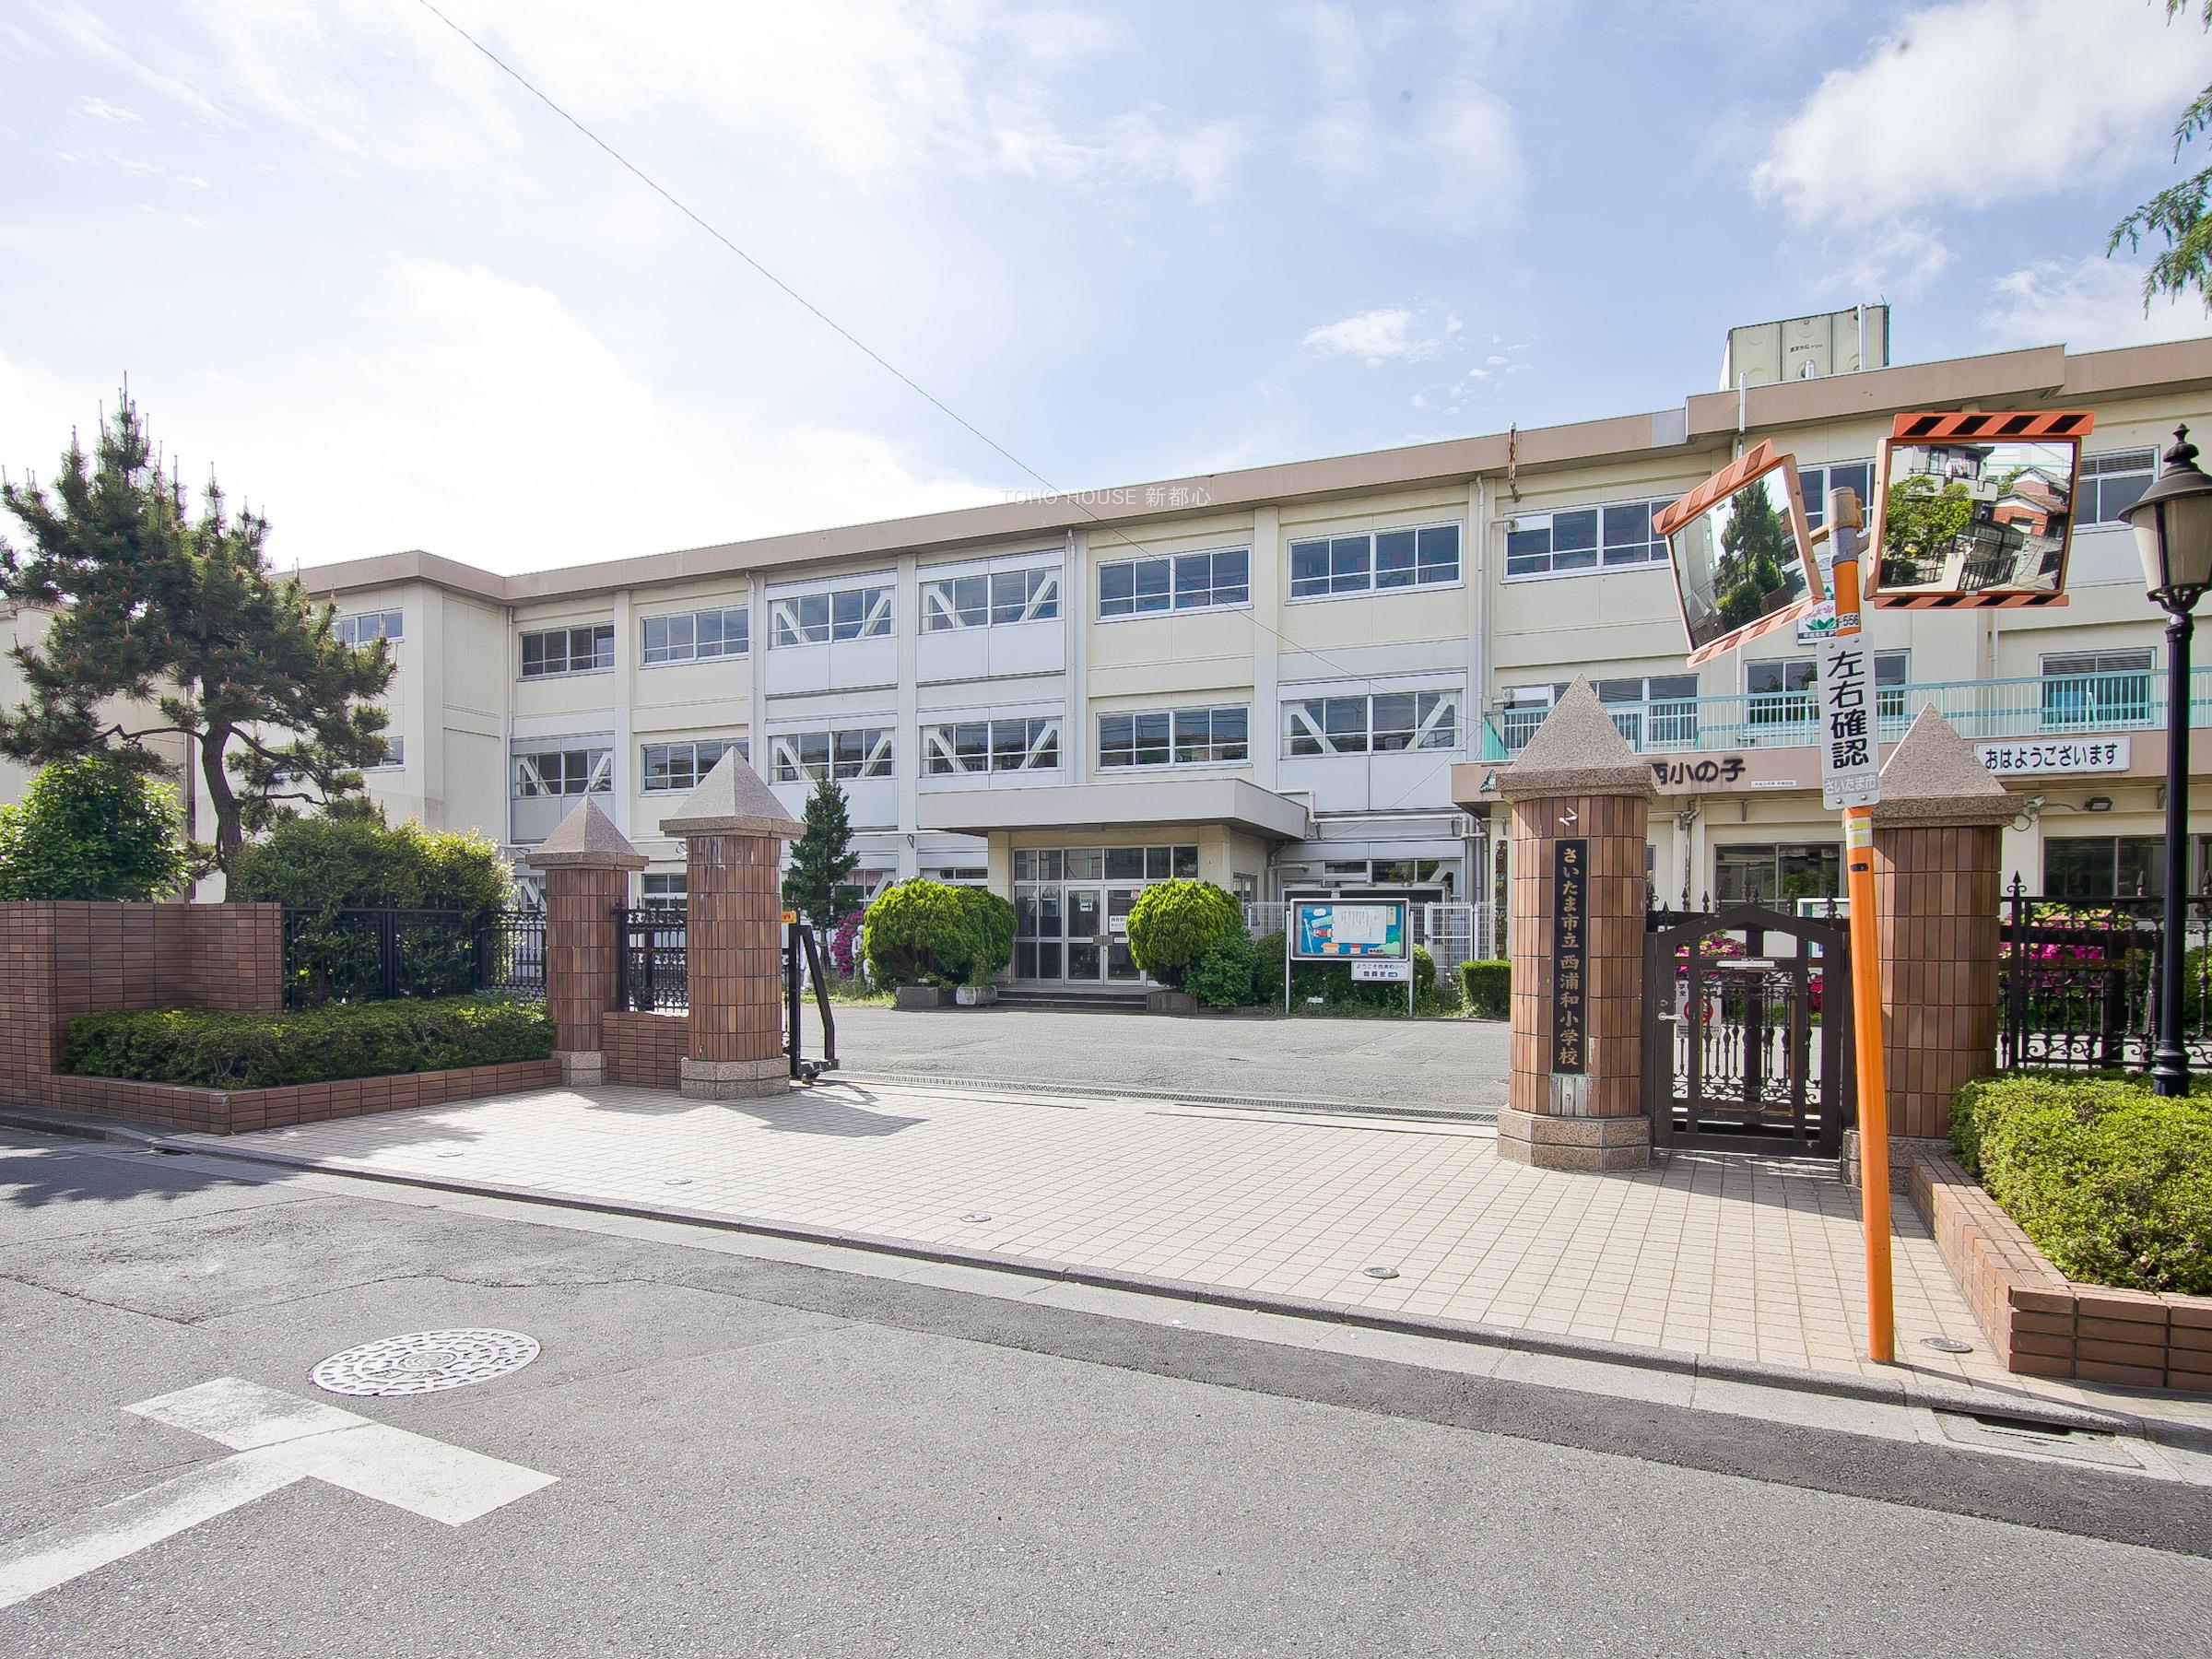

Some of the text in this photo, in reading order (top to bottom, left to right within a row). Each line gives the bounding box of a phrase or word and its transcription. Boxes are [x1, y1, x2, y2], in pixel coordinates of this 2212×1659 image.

[1827, 650, 1869, 770] 左右確認
[1985, 742, 2118, 770] おはようございます
[1825, 774, 1876, 794] さいたま市
